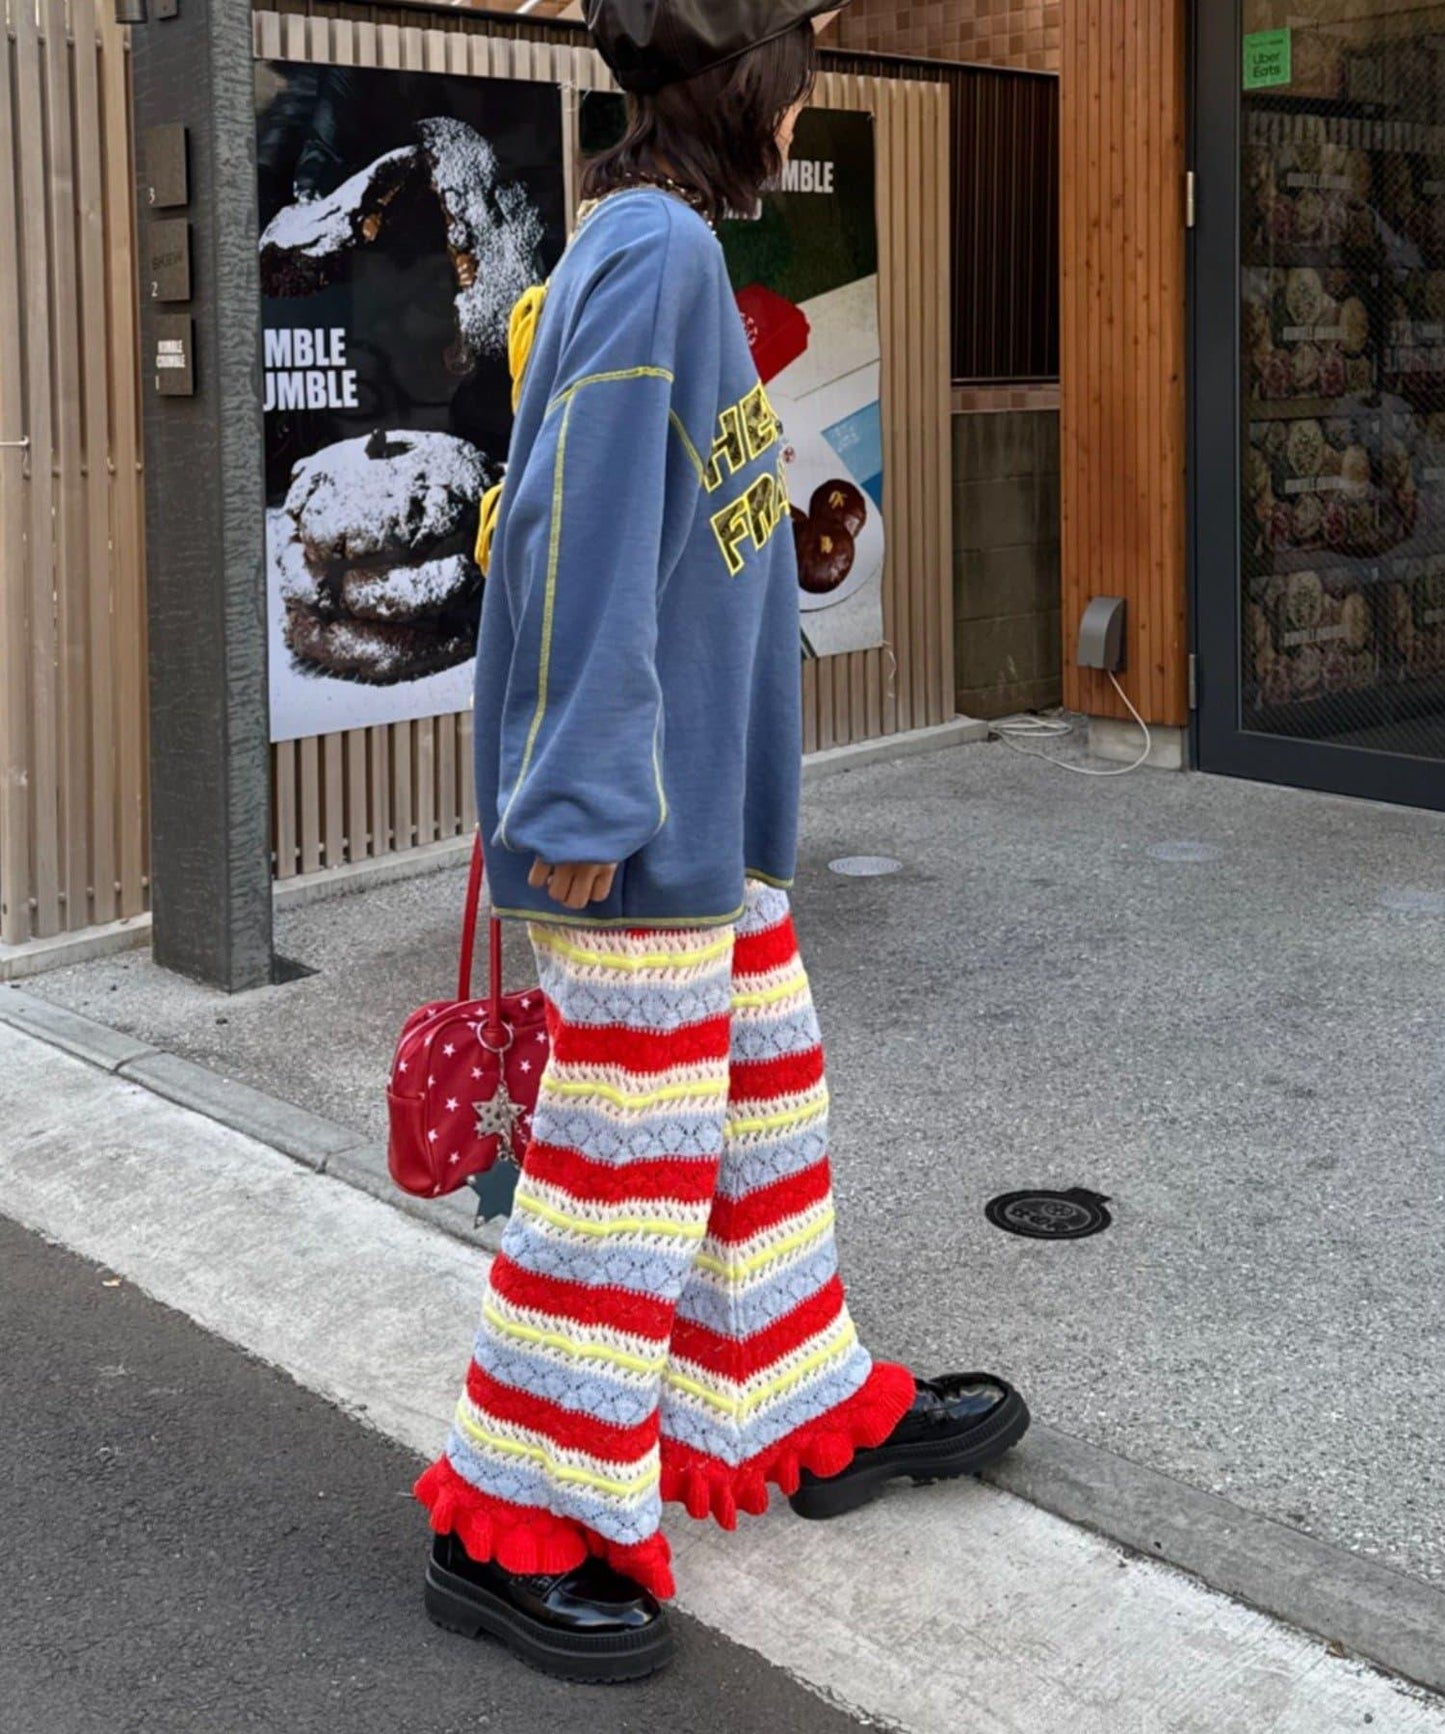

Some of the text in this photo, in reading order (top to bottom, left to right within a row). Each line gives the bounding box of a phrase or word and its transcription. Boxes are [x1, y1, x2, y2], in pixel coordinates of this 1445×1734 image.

[1252, 51, 1281, 65] Uber
[1252, 65, 1282, 78] Eats
[780, 159, 834, 193] MBLE
[149, 187, 156, 205] 3
[151, 281, 158, 297] 2
[263, 327, 347, 368] MBLE
[262, 369, 359, 412] UMBLE
[710, 456, 790, 577] FRA
